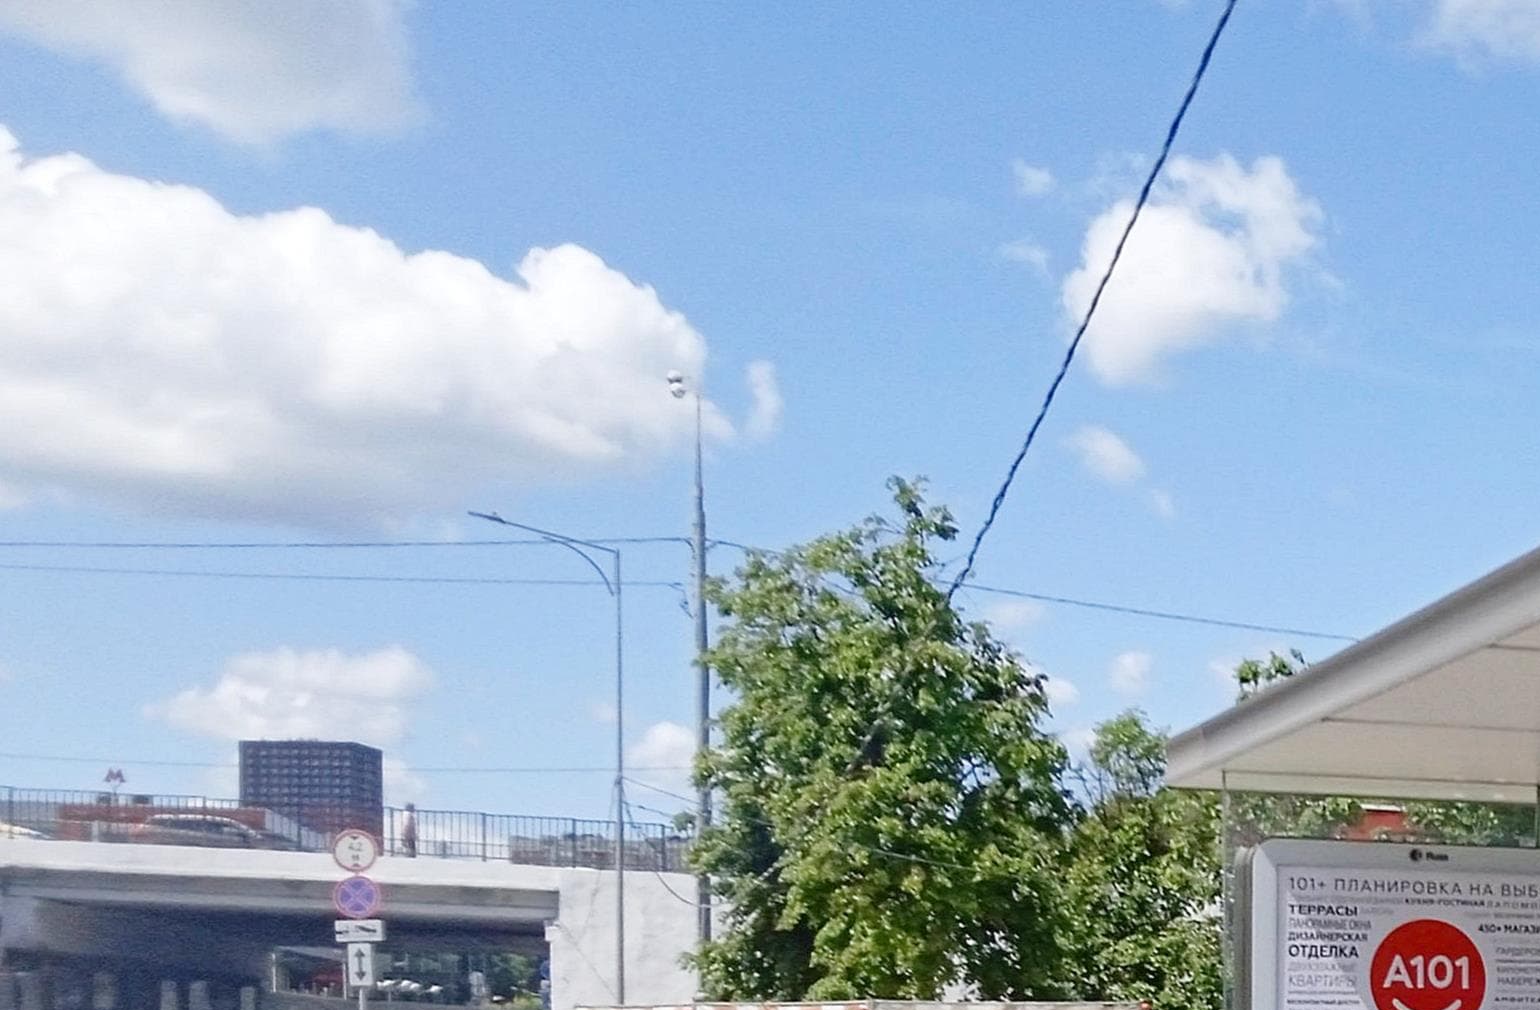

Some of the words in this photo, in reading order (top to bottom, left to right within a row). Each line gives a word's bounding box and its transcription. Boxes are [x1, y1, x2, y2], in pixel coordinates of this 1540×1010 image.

[1289, 877, 1326, 891] 101+
[1334, 878, 1462, 895] ПЛАНИРОВКА
[1470, 883, 1493, 896] НА
[1288, 904, 1358, 917] ТЕРРАСЫ
[1288, 944, 1360, 959] ОТДЕЛКА
[1288, 974, 1357, 987] КВАРТИРЫ
